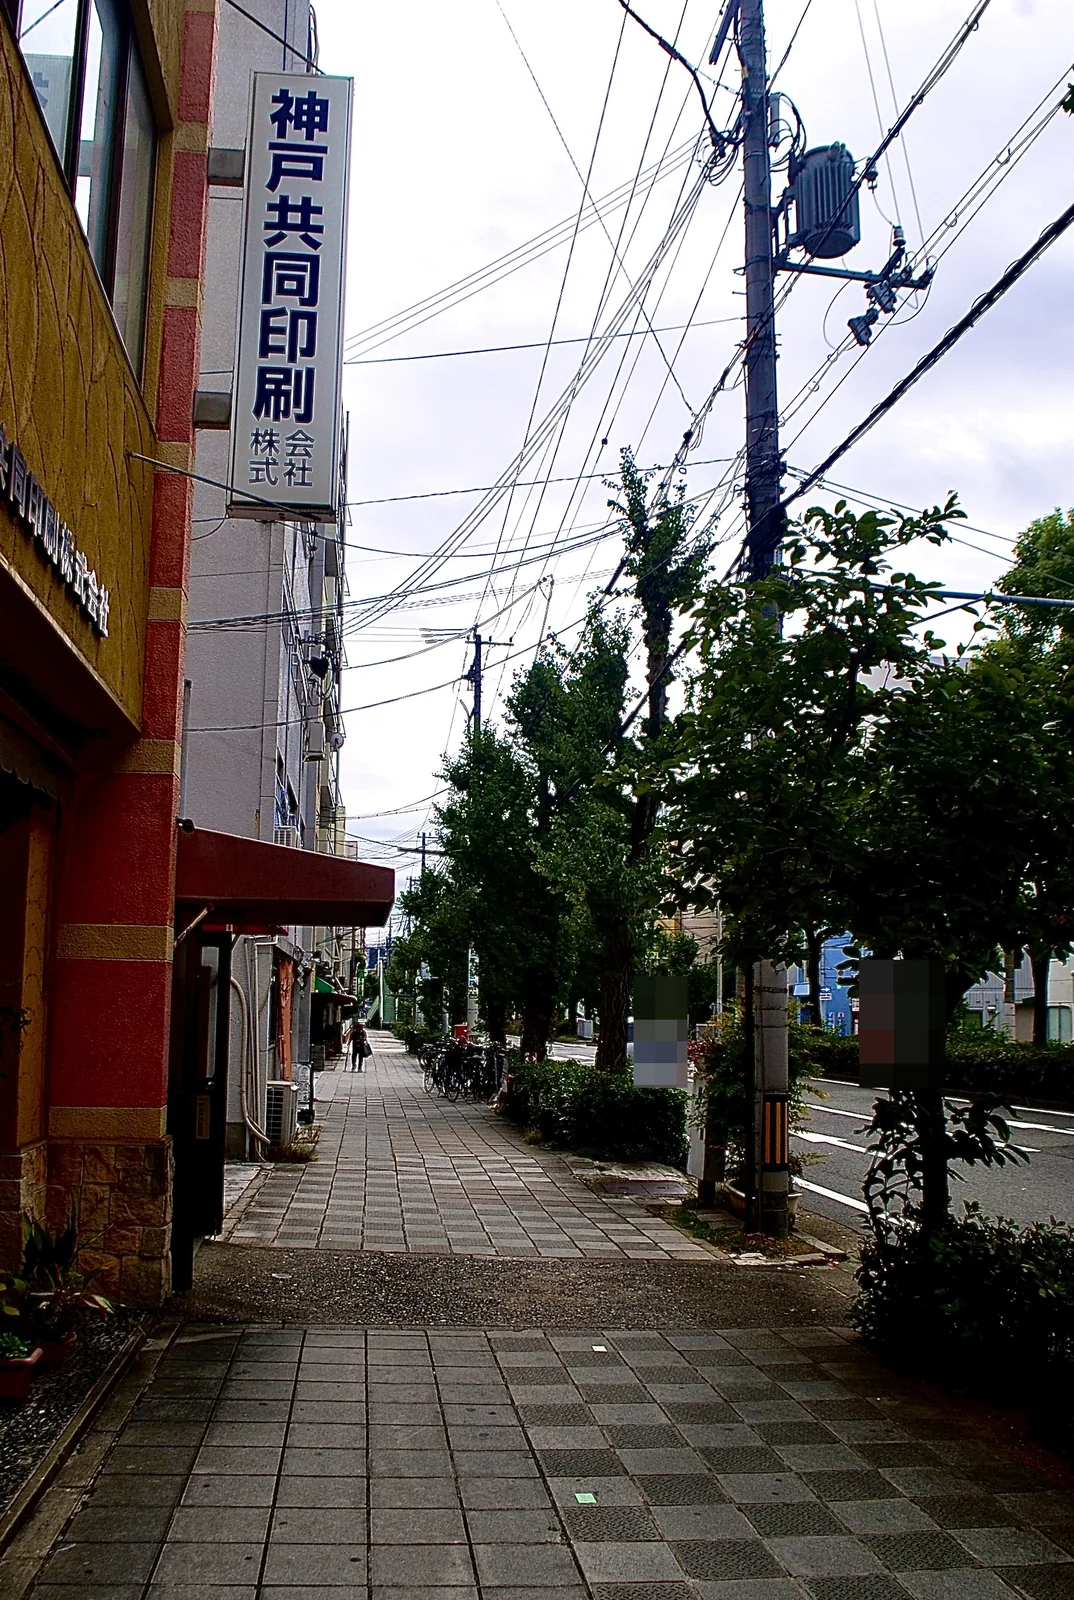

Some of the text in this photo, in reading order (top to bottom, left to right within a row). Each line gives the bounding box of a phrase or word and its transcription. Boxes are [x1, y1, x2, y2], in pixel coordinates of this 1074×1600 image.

[252, 88, 329, 424] 神戸共同印刷
